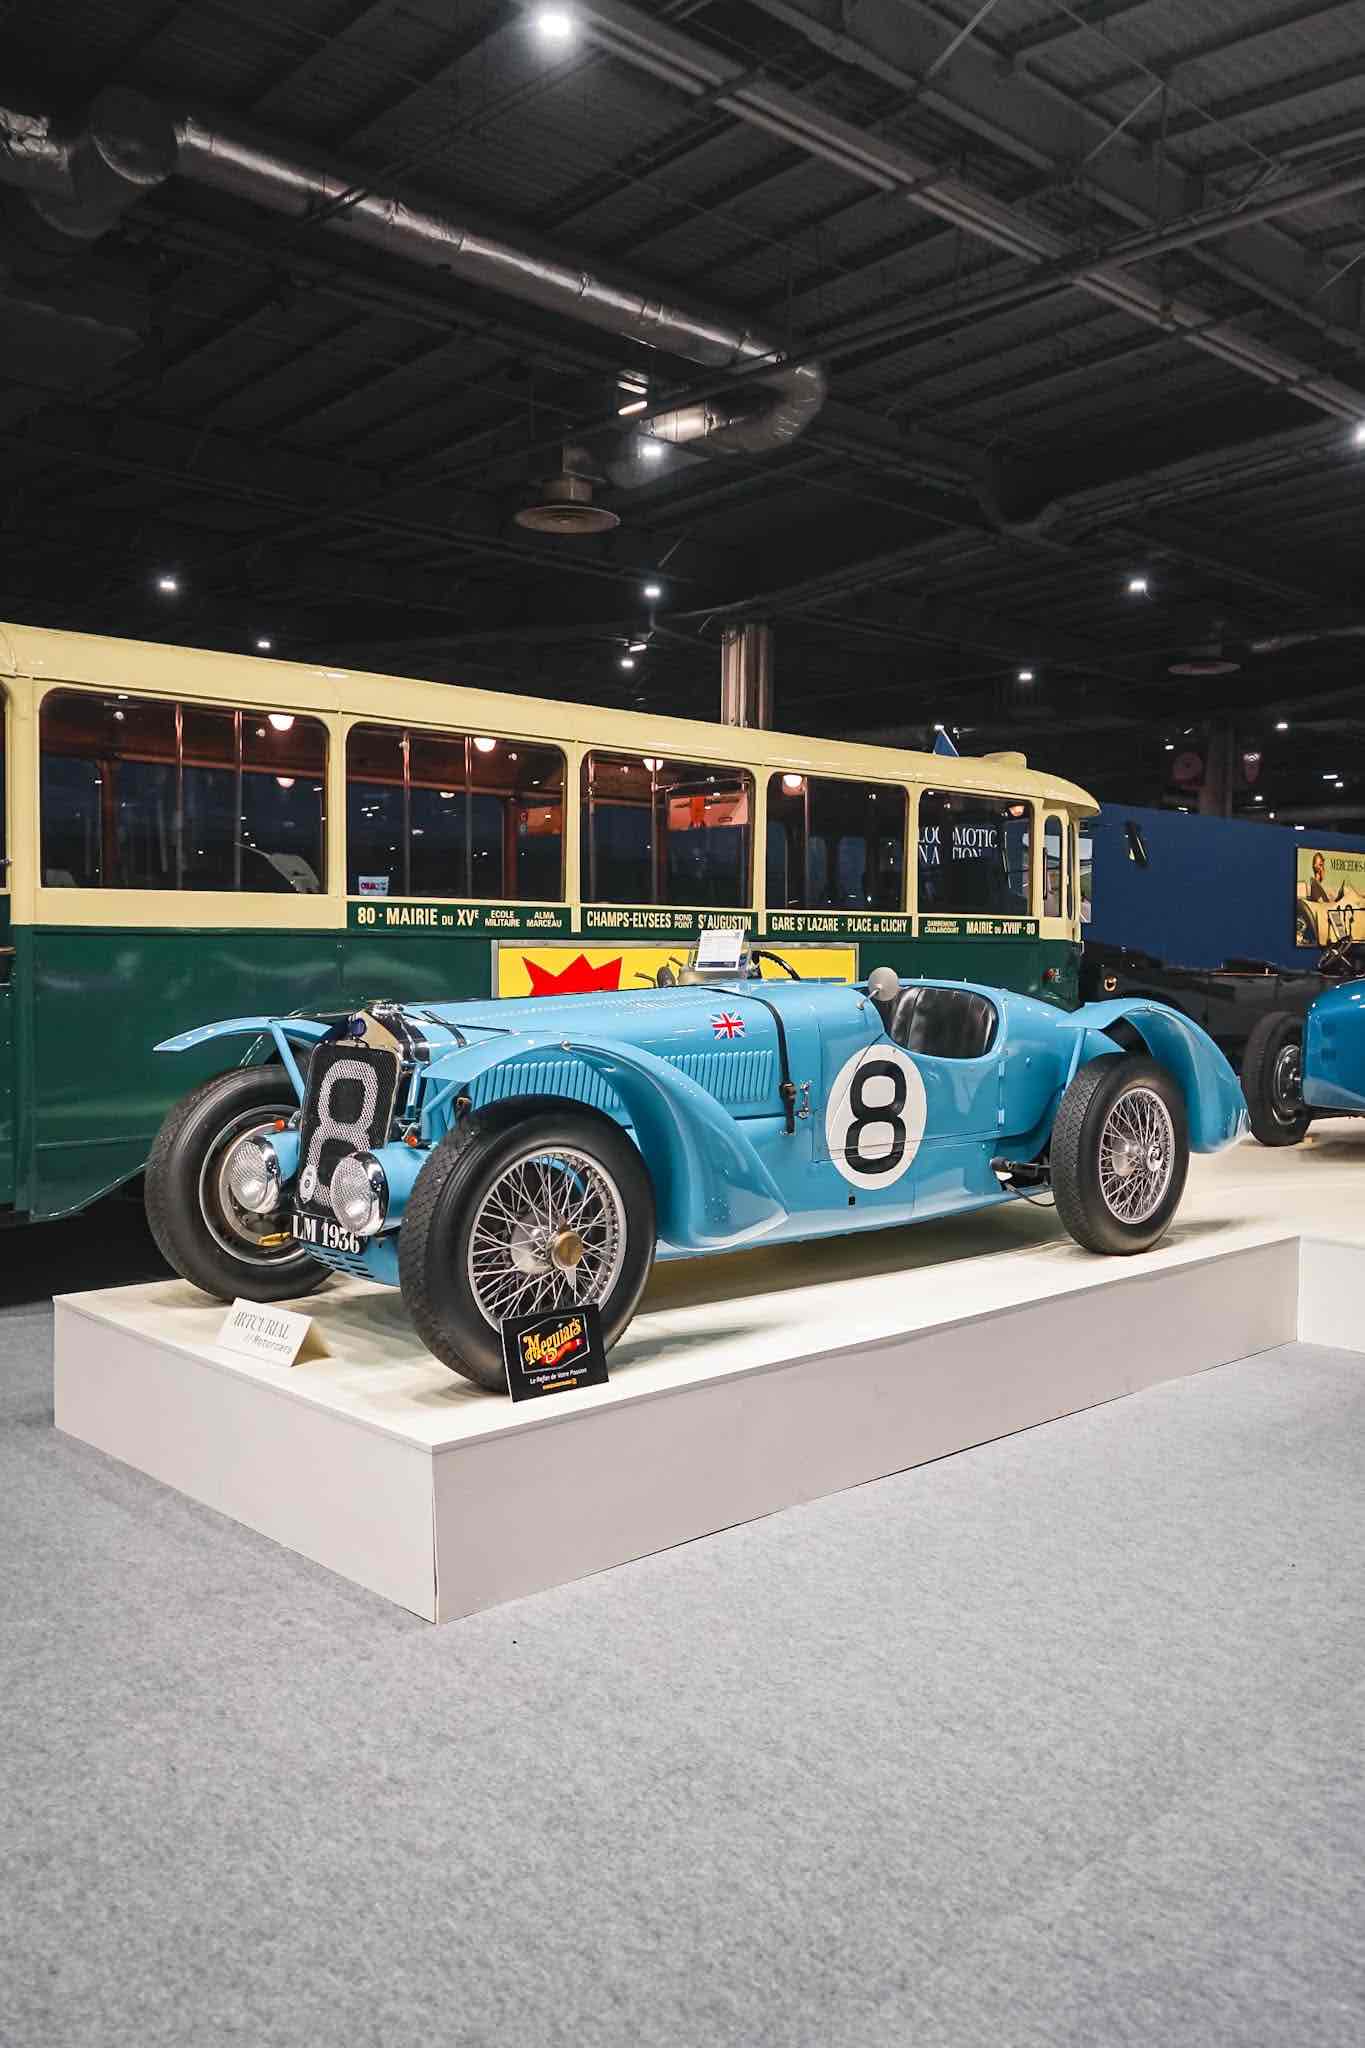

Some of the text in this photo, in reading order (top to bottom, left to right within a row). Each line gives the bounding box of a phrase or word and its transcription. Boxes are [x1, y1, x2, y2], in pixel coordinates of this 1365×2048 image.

[357, 907, 376, 925] 80
[386, 907, 438, 926] MAIRIE
[441, 915, 454, 926] DU
[484, 918, 520, 927] MILITAIRE
[490, 910, 515, 919] ECOLE
[526, 919, 562, 928] MARCEAU
[534, 911, 555, 919] ALMA
[586, 910, 672, 929] CHAMPS-ELYSEES
[707, 915, 752, 930] AUGUSTIN
[674, 920, 693, 929] POINT
[771, 916, 795, 931] GARE
[807, 917, 839, 932] LAZARE
[847, 918, 872, 932] PLACE
[881, 919, 908, 933] CLICHY
[966, 921, 993, 934] MAIRIE
[1026, 922, 1036, 935] 80
[844, 1060, 907, 1175] 8
[306, 1059, 378, 1208] 8
[292, 1214, 360, 1253] LM 1936
[232, 1311, 290, 1339] ARTCURIAL
[523, 1317, 582, 1365] Meguiar's
